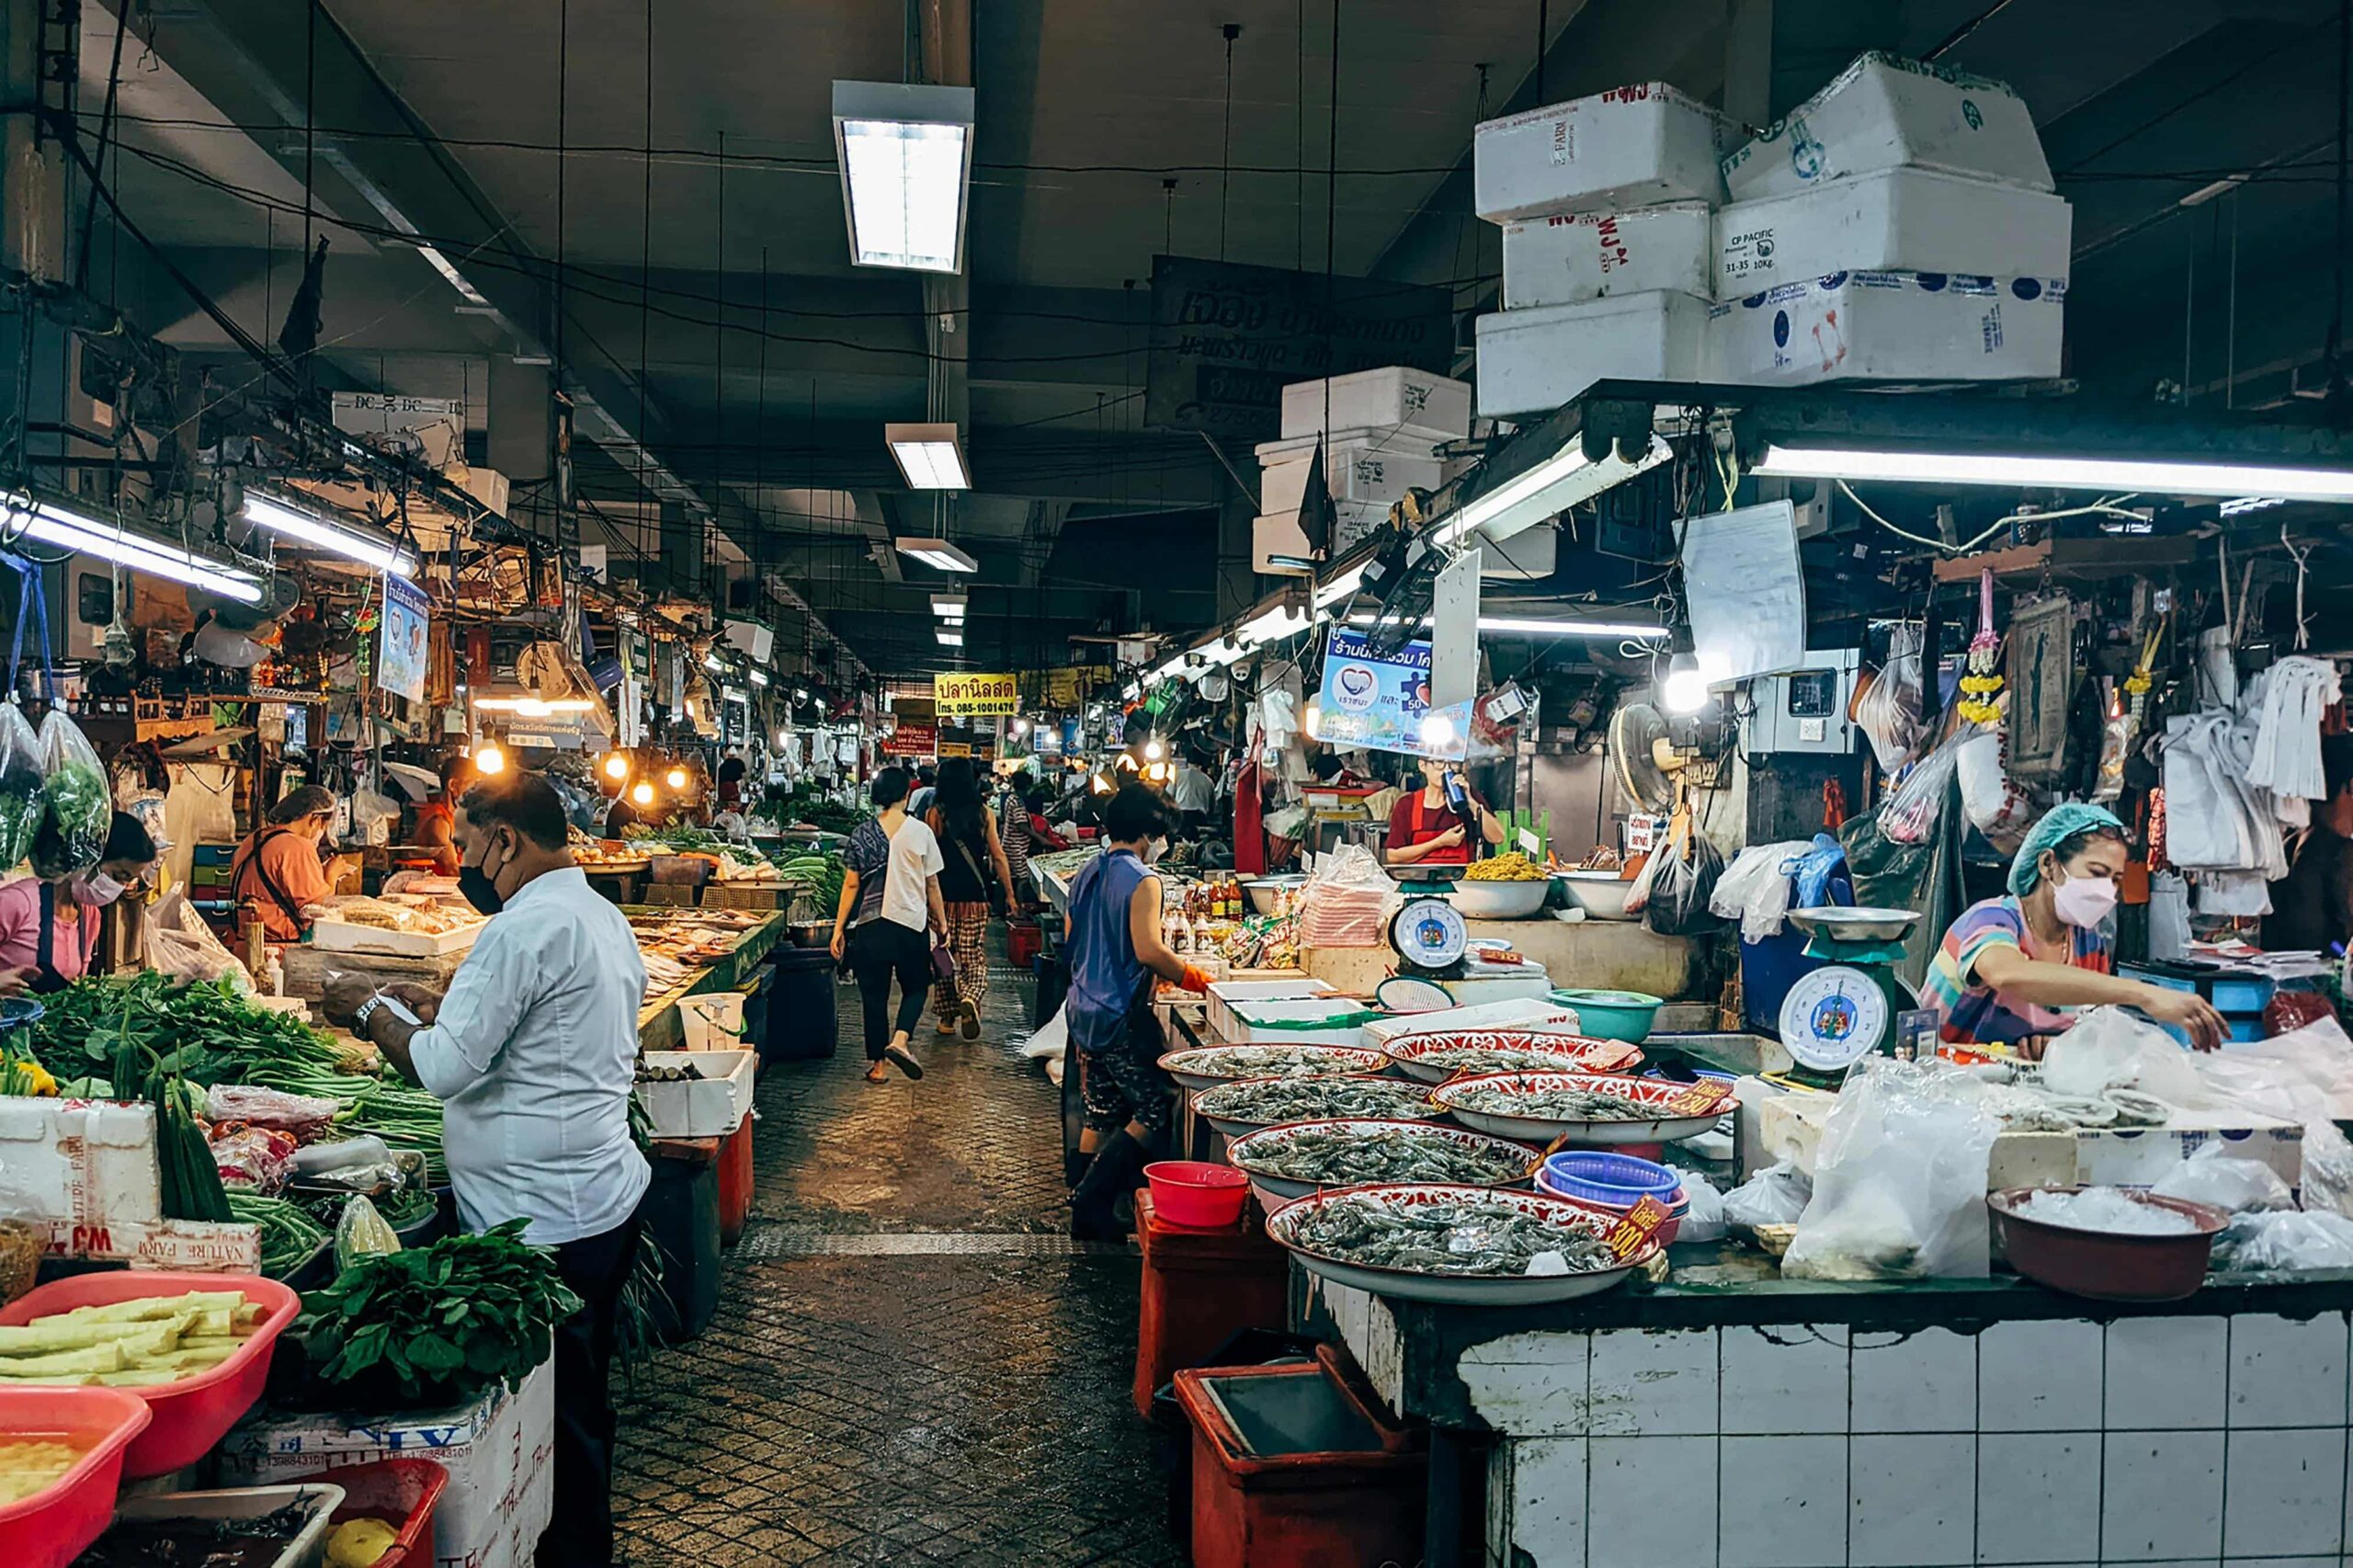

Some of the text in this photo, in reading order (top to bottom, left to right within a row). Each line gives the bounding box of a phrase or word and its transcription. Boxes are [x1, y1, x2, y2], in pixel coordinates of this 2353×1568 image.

[1732, 228, 1774, 245] CP PACIFIC
[354, 395, 376, 410] DC
[403, 399, 422, 413] DC
[938, 677, 1014, 699] ปลานิลสด
[938, 700, 1015, 713] โทร. 085-1001476
[1338, 696, 1369, 707] เราชนะ
[1381, 694, 1399, 706] และ
[1408, 699, 1421, 710] 50
[1667, 1093, 1711, 1113] 230
[1606, 1220, 1643, 1257] 300
[138, 1240, 176, 1257] FARM
[188, 1243, 244, 1260] NATURE
